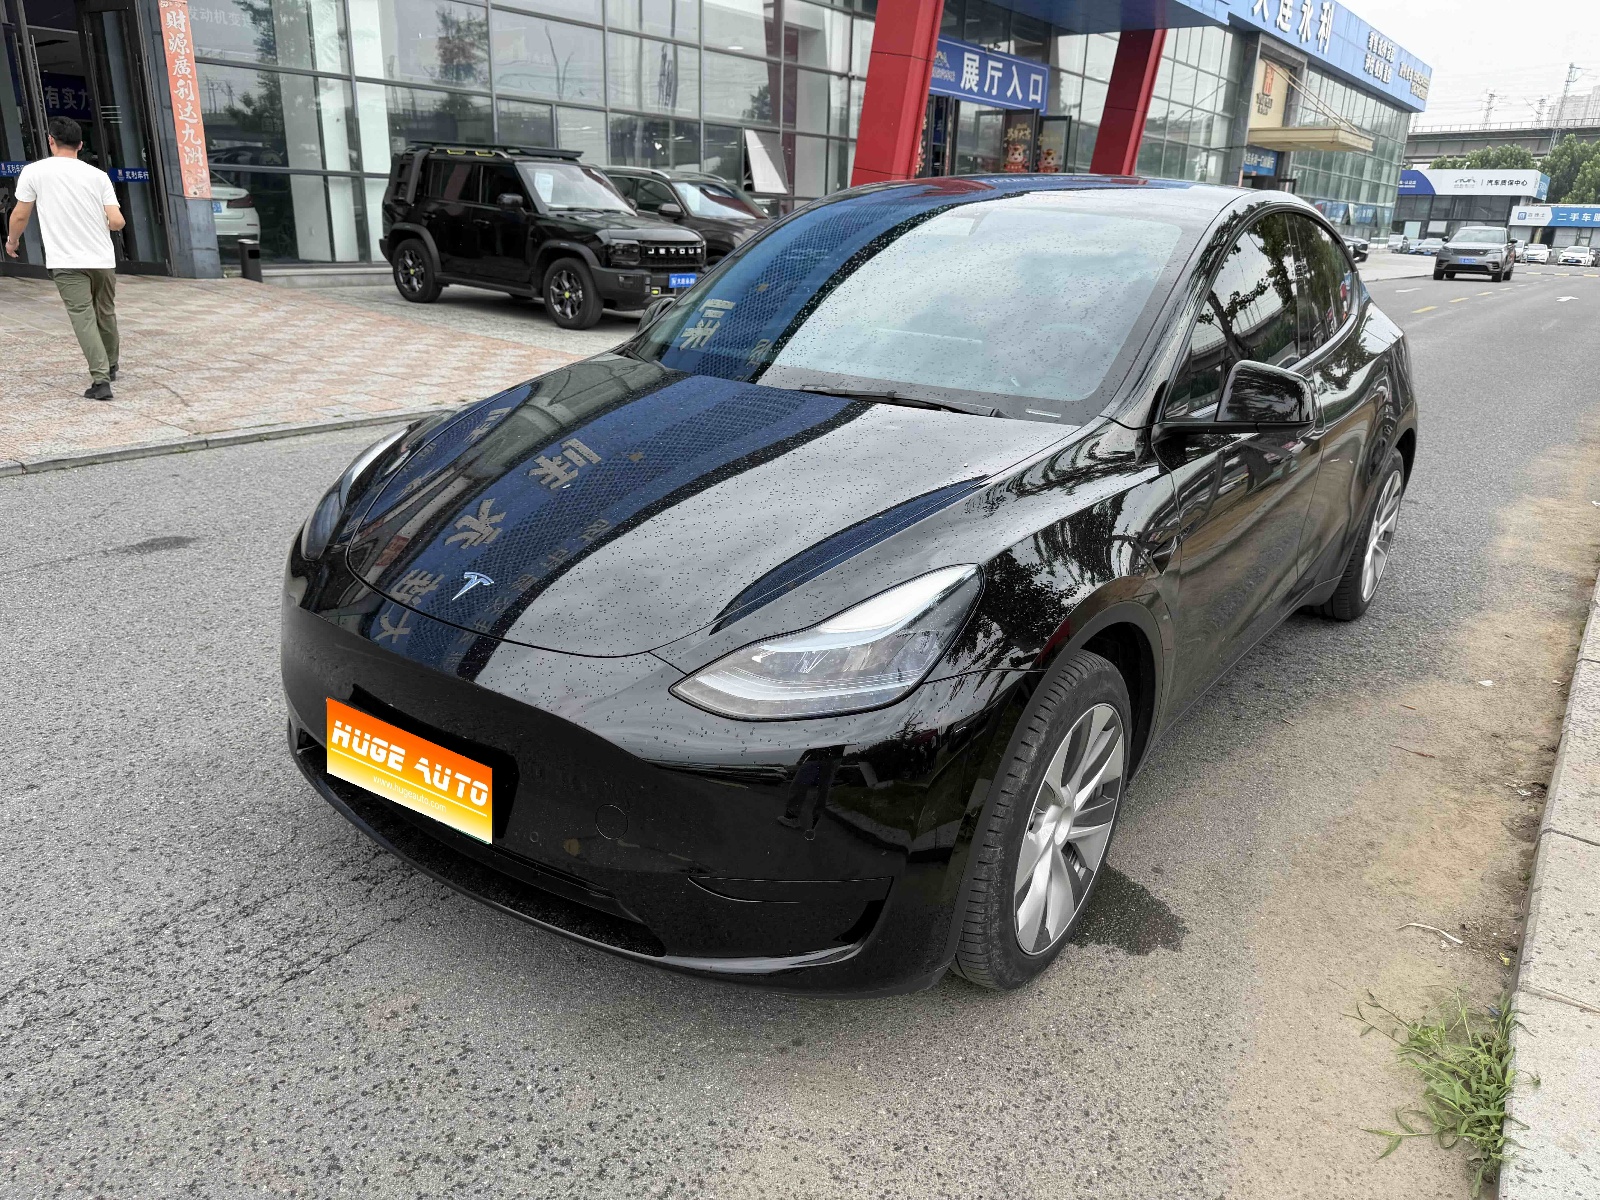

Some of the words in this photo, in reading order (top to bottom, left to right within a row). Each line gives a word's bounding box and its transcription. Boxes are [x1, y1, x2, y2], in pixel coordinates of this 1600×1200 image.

[960, 51, 1043, 103] 展厅入口
[1486, 178, 1528, 187] 汽车质保中心
[648, 247, 702, 255] JETOUR
